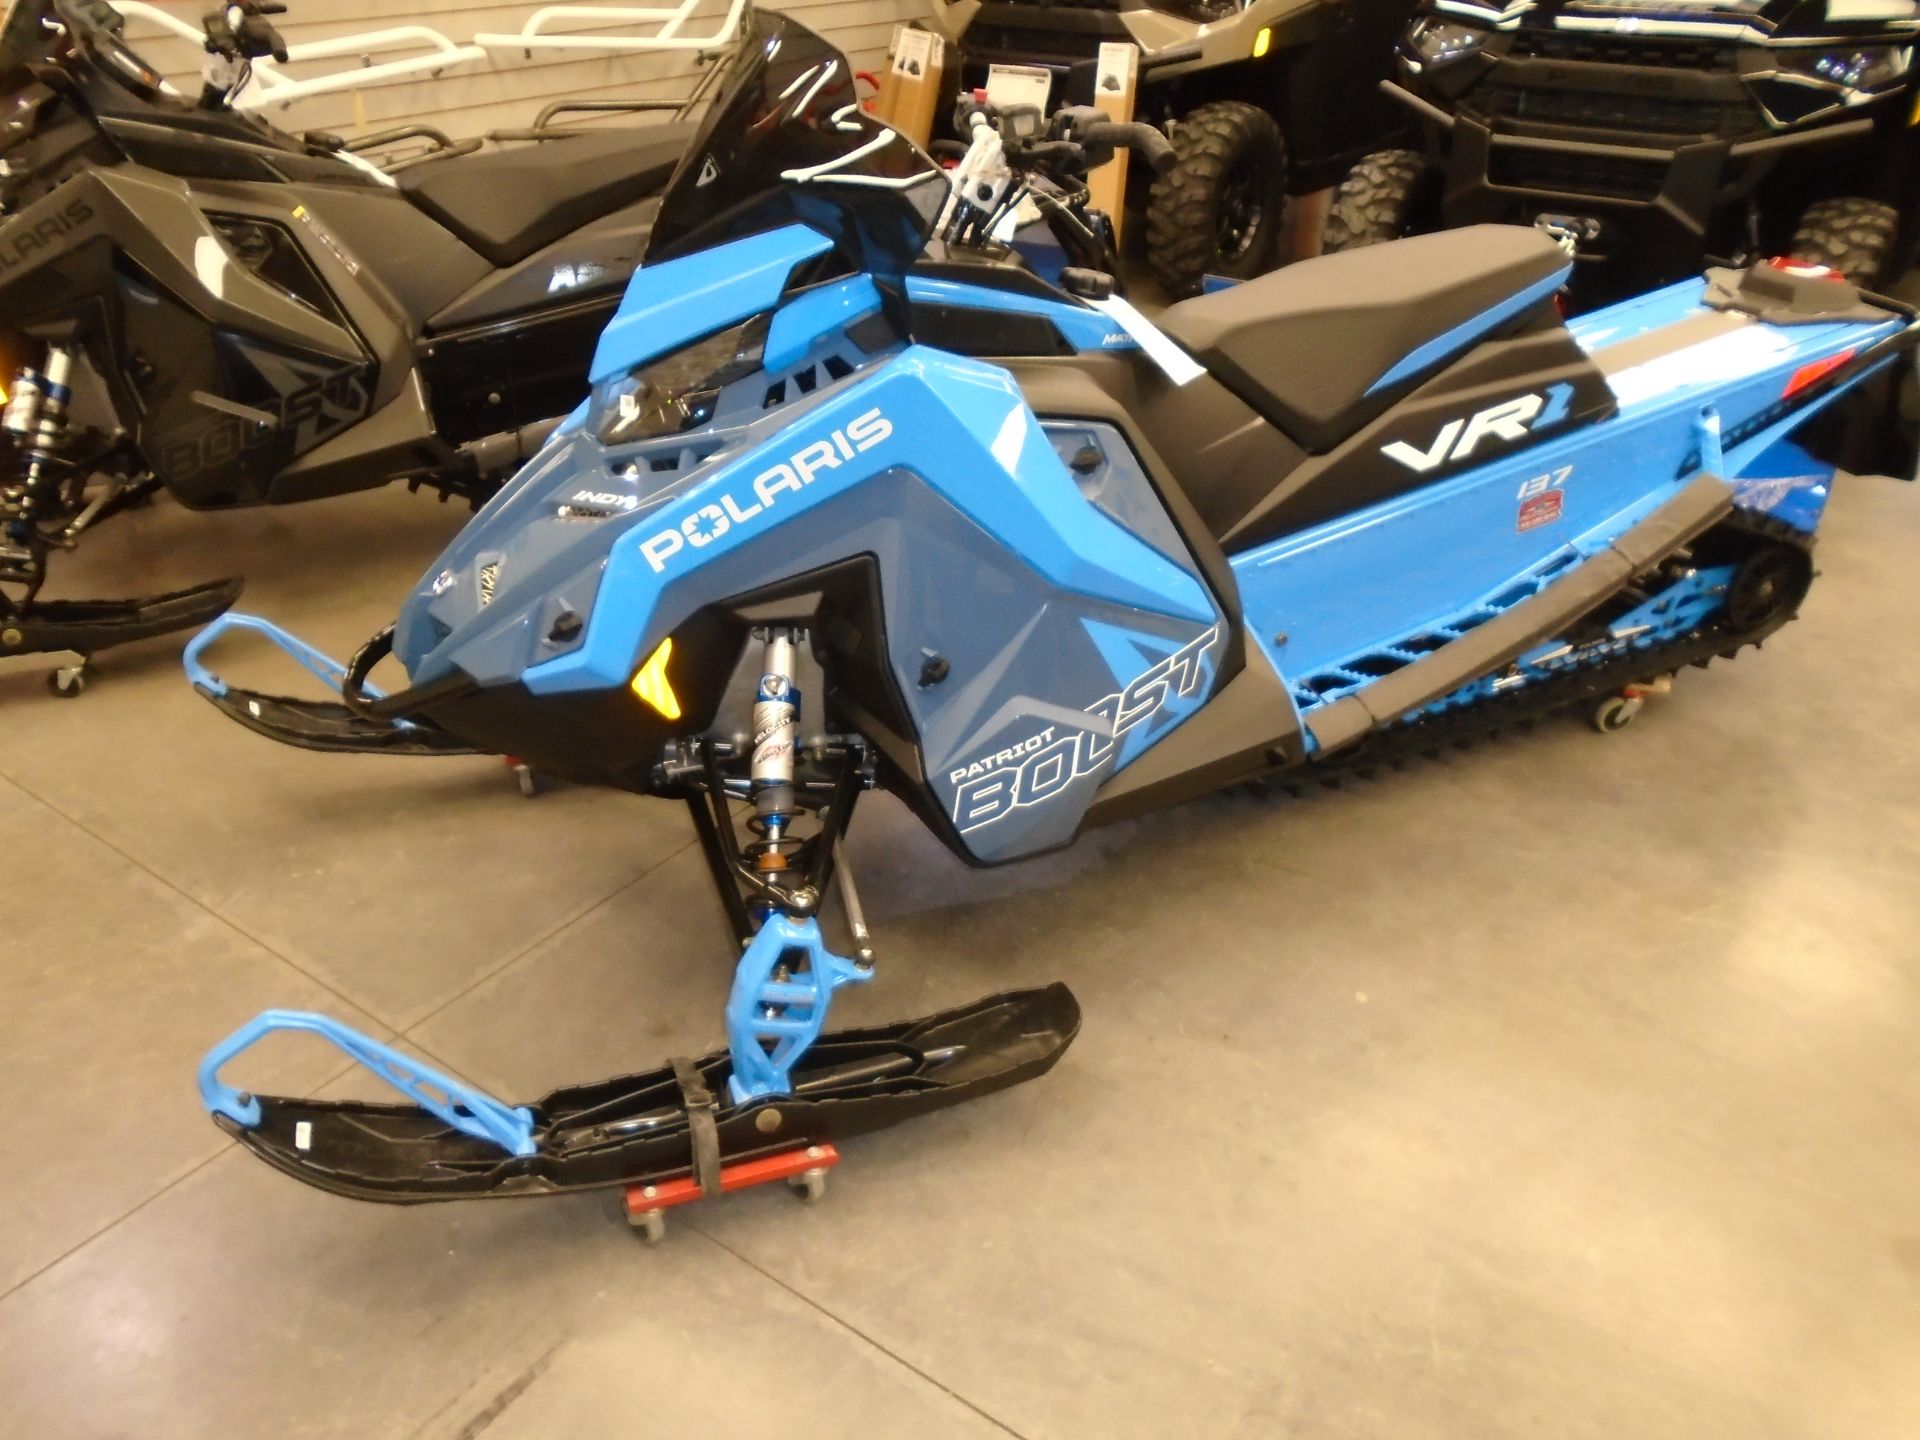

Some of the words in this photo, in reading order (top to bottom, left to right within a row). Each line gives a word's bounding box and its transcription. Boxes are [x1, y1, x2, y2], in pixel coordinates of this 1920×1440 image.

[1380, 382, 1575, 472] VR1
[638, 407, 893, 573] POLARIS
[1516, 464, 1574, 500] 137
[950, 726, 1055, 784] PATRIOT
[953, 626, 1220, 834] BOOST
